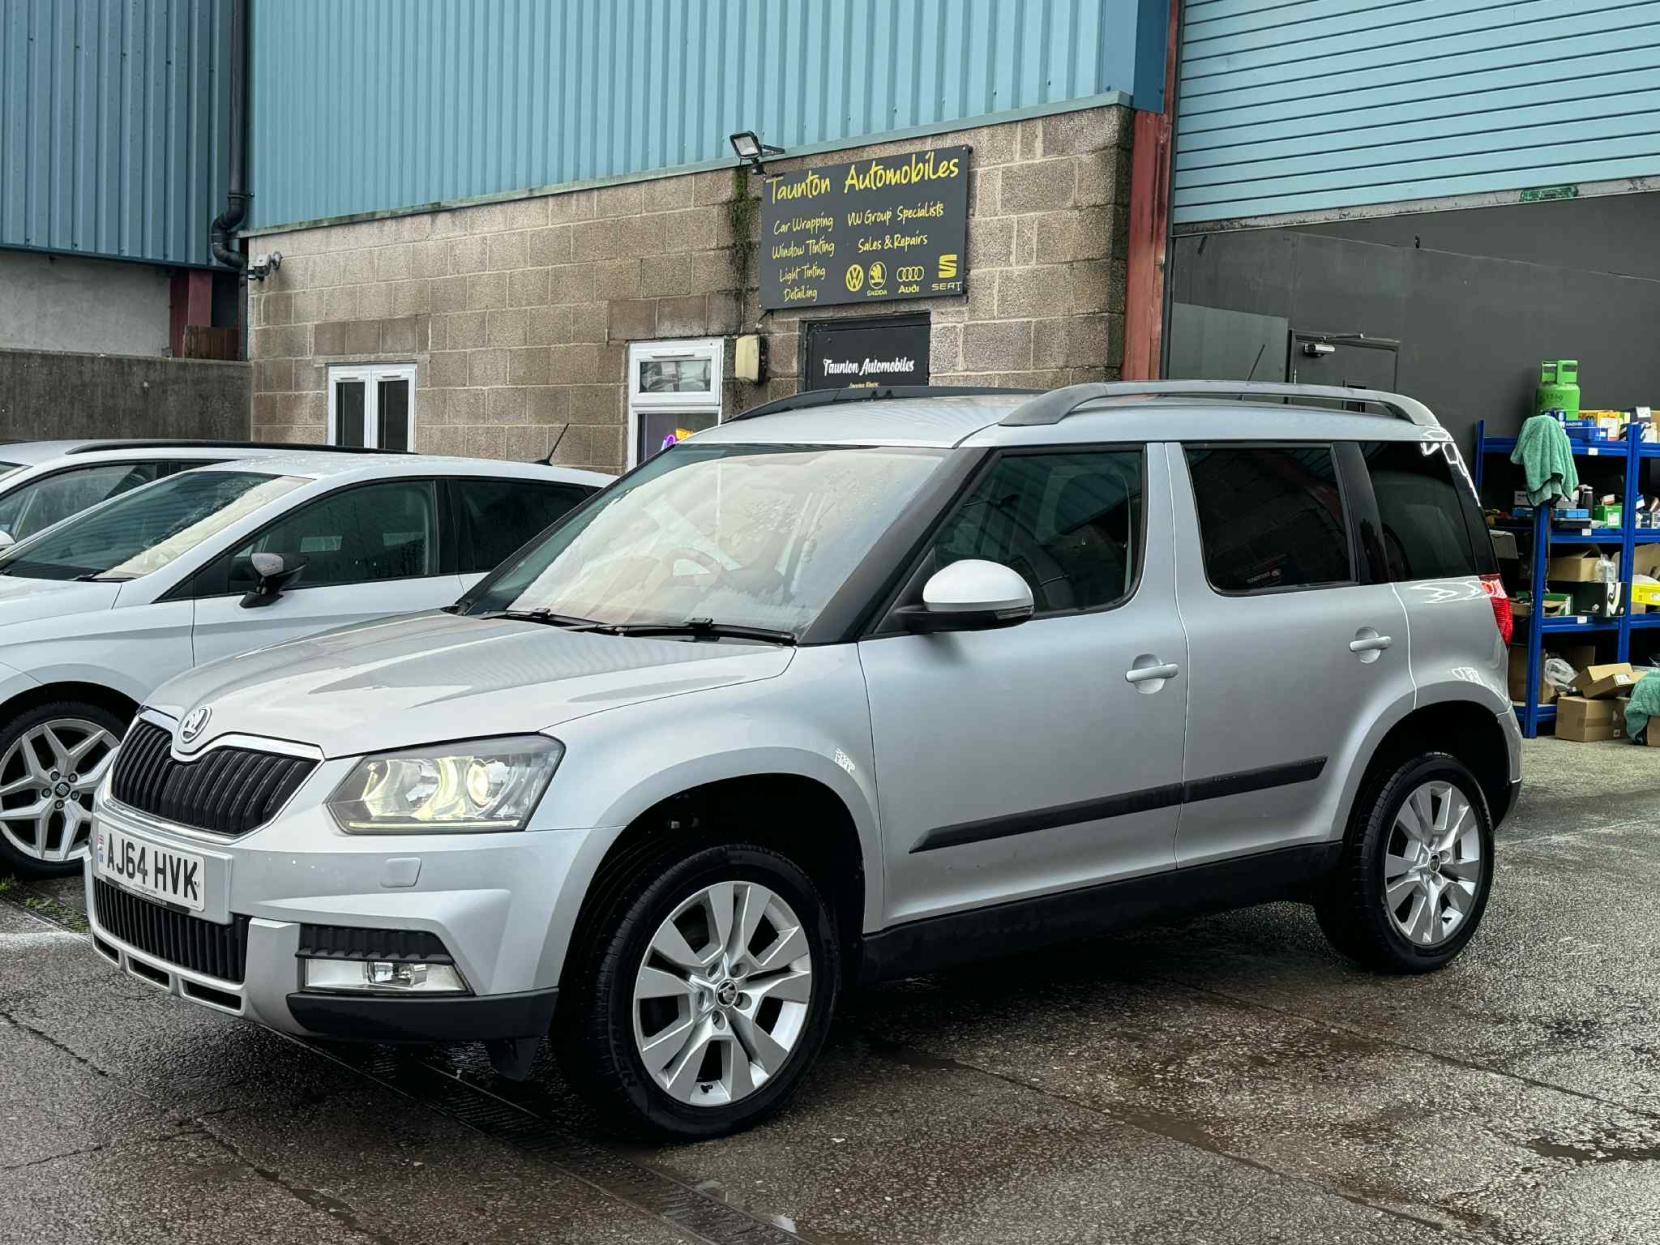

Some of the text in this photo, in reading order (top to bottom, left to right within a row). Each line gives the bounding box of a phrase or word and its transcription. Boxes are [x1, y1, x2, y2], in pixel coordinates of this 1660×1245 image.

[766, 151, 959, 204] Taunton Automobiles
[773, 212, 834, 235] Car Wrapping
[848, 201, 944, 227] VW Group Specialists
[772, 235, 835, 260] Window Tinting
[858, 230, 928, 253] Sales & Repairs
[779, 261, 826, 285] Light Tinting
[784, 285, 818, 303] Detailing
[898, 284, 920, 294] Audi
[931, 281, 963, 292] SEAT
[823, 356, 915, 377] Taunton Automobiles
[107, 832, 148, 885] AJ64
[154, 850, 198, 901] HVK
